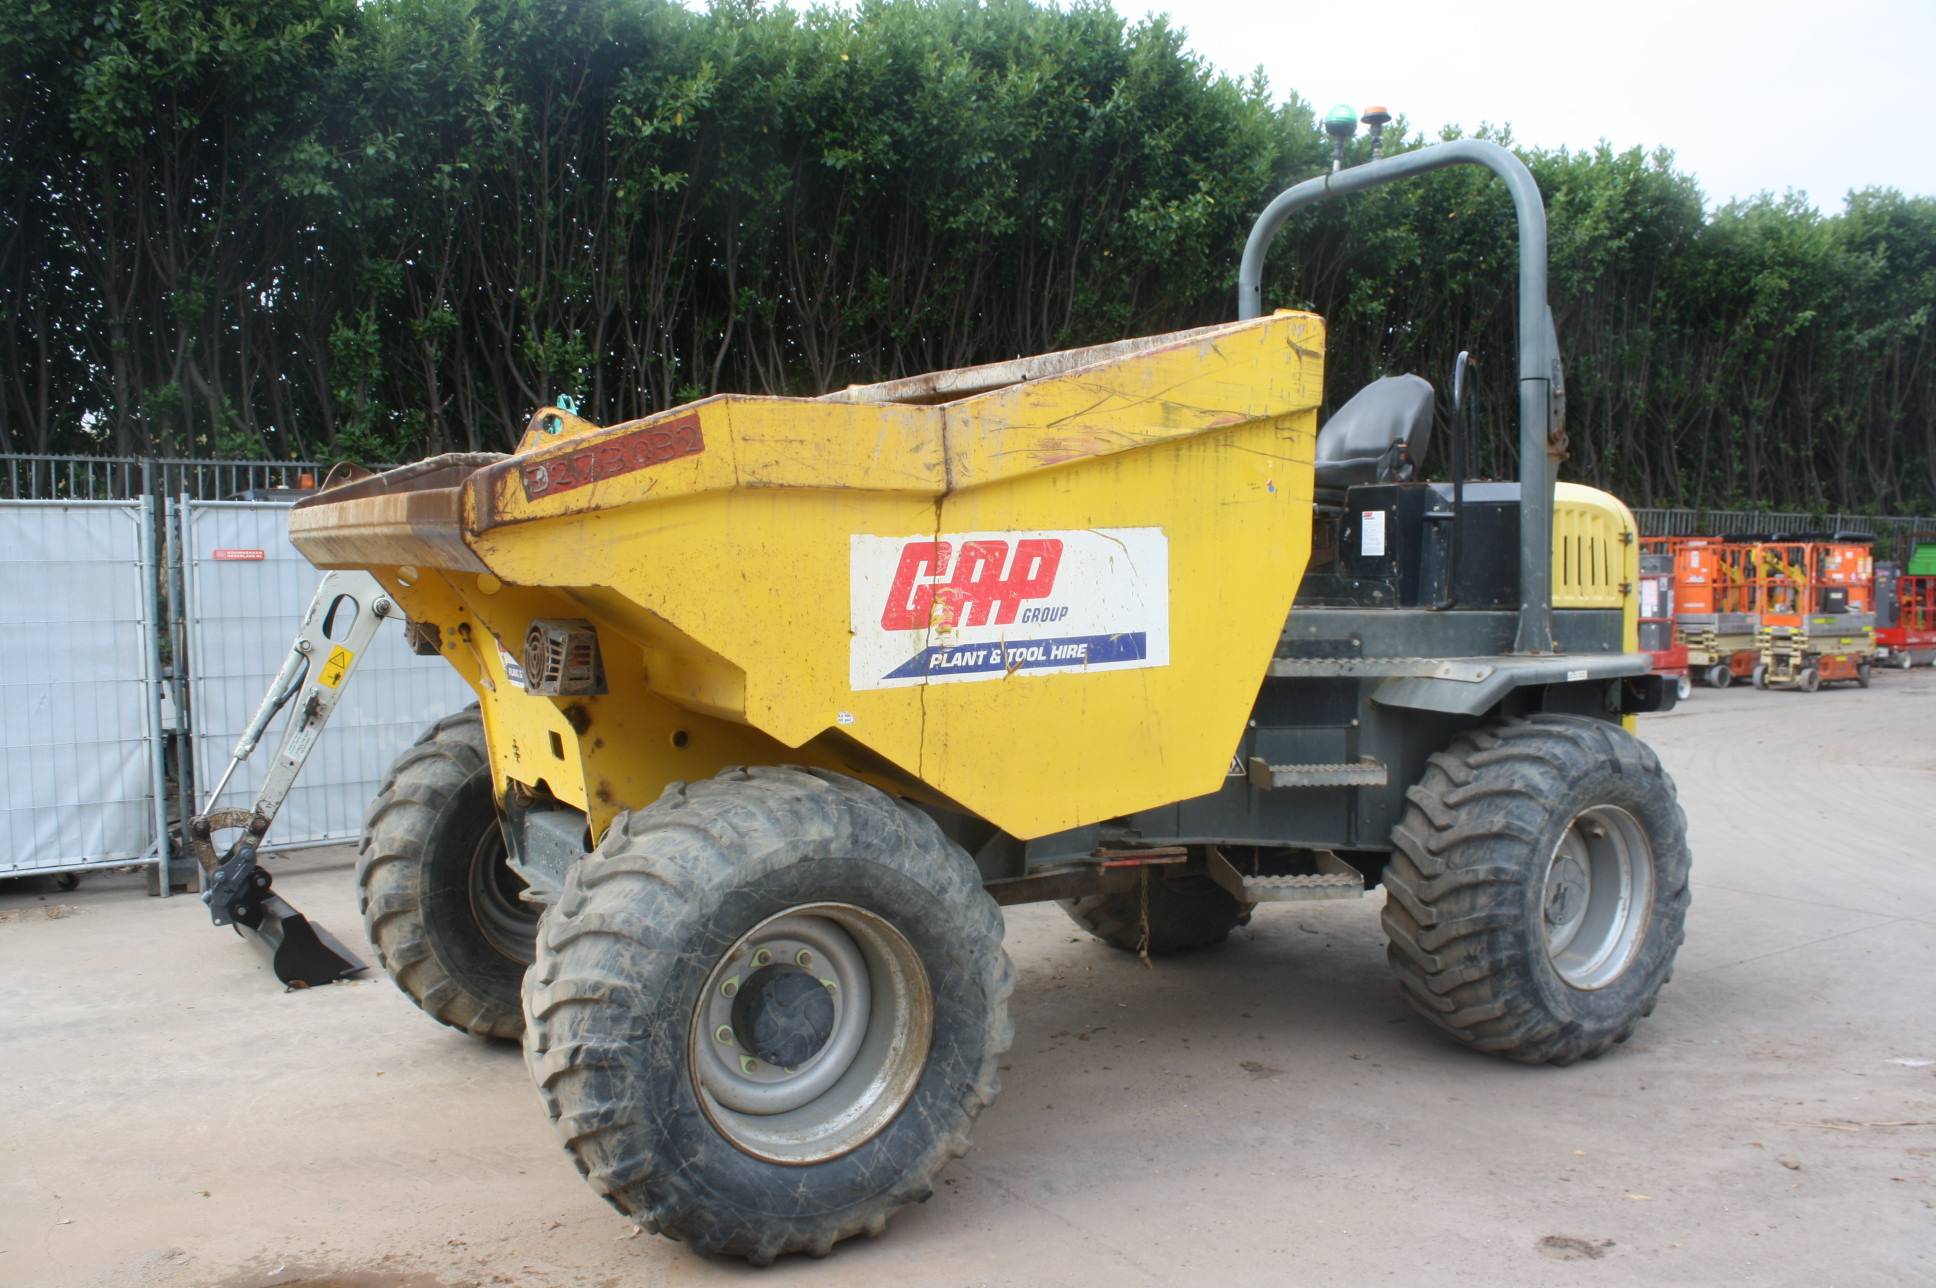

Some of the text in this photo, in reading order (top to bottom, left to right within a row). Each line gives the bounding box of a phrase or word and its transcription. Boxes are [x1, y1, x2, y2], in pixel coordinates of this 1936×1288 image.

[881, 538, 1064, 631] GAP
[1021, 606, 1069, 623] GROUP
[929, 643, 1088, 668] PLANT & TOOL HIRE
